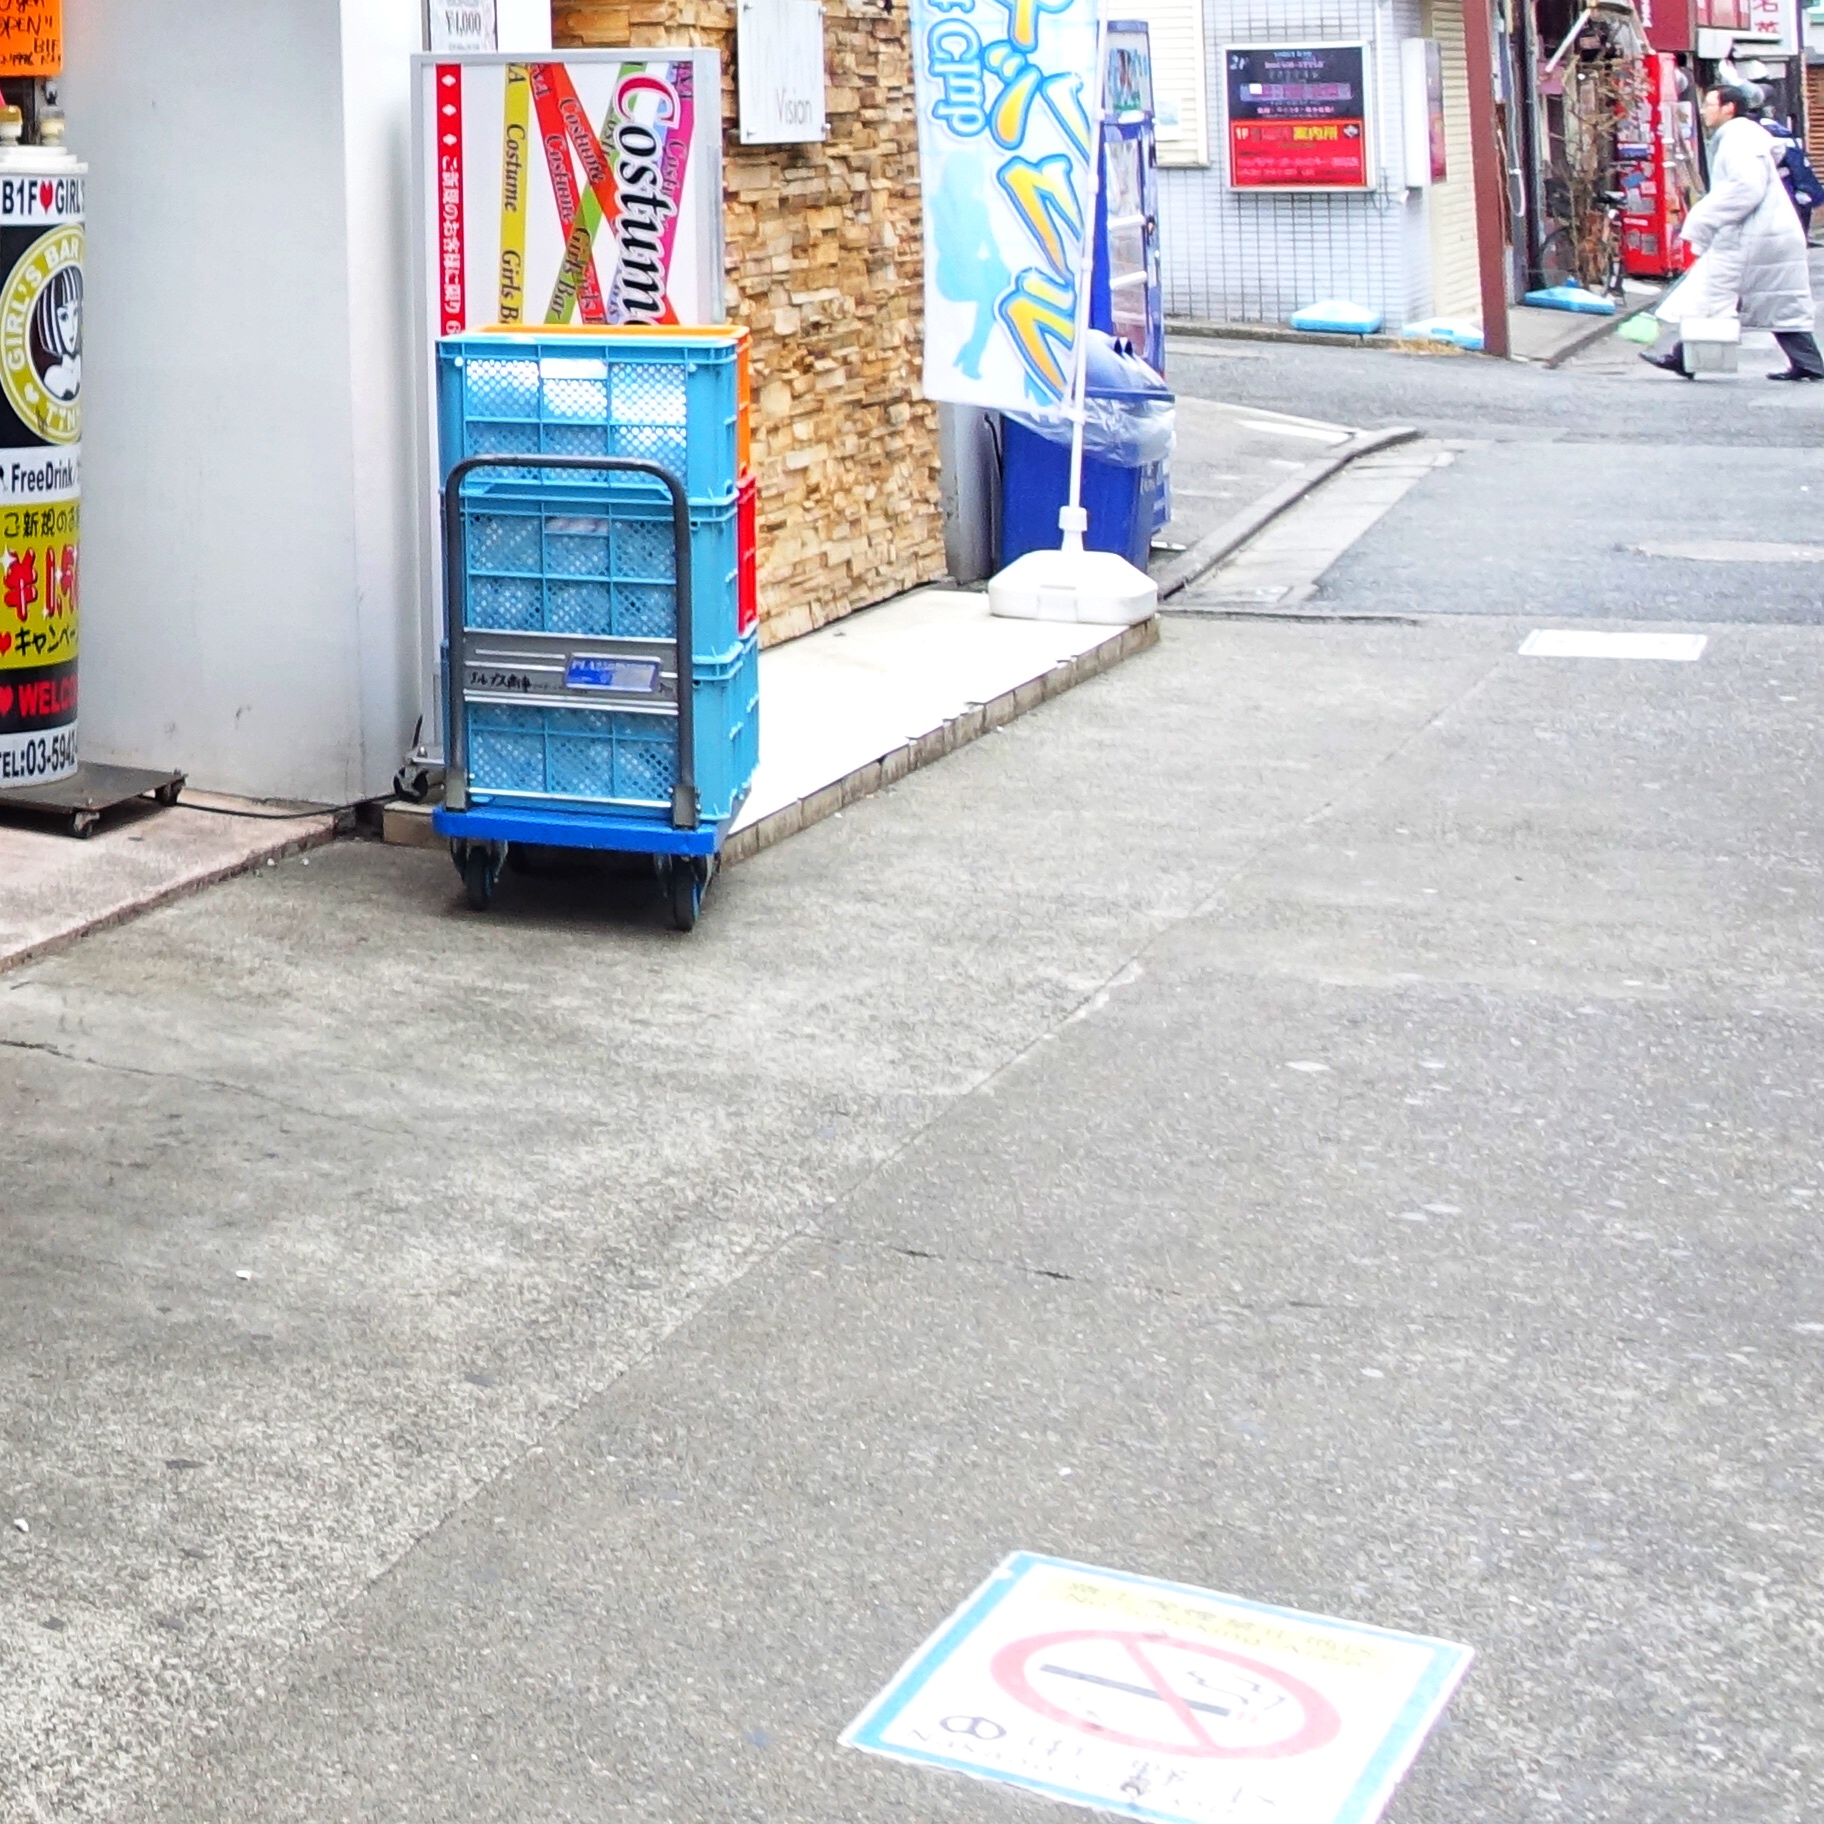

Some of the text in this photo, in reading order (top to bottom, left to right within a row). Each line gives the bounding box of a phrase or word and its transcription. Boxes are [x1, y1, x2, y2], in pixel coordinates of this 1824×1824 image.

[774, 87, 814, 126] Vision
[1, 178, 39, 216] B1F
[504, 123, 525, 213] Costume
[616, 74, 679, 326] Costum
[3, 236, 80, 373] GIRL'S BAR
[500, 249, 521, 300] Girls
